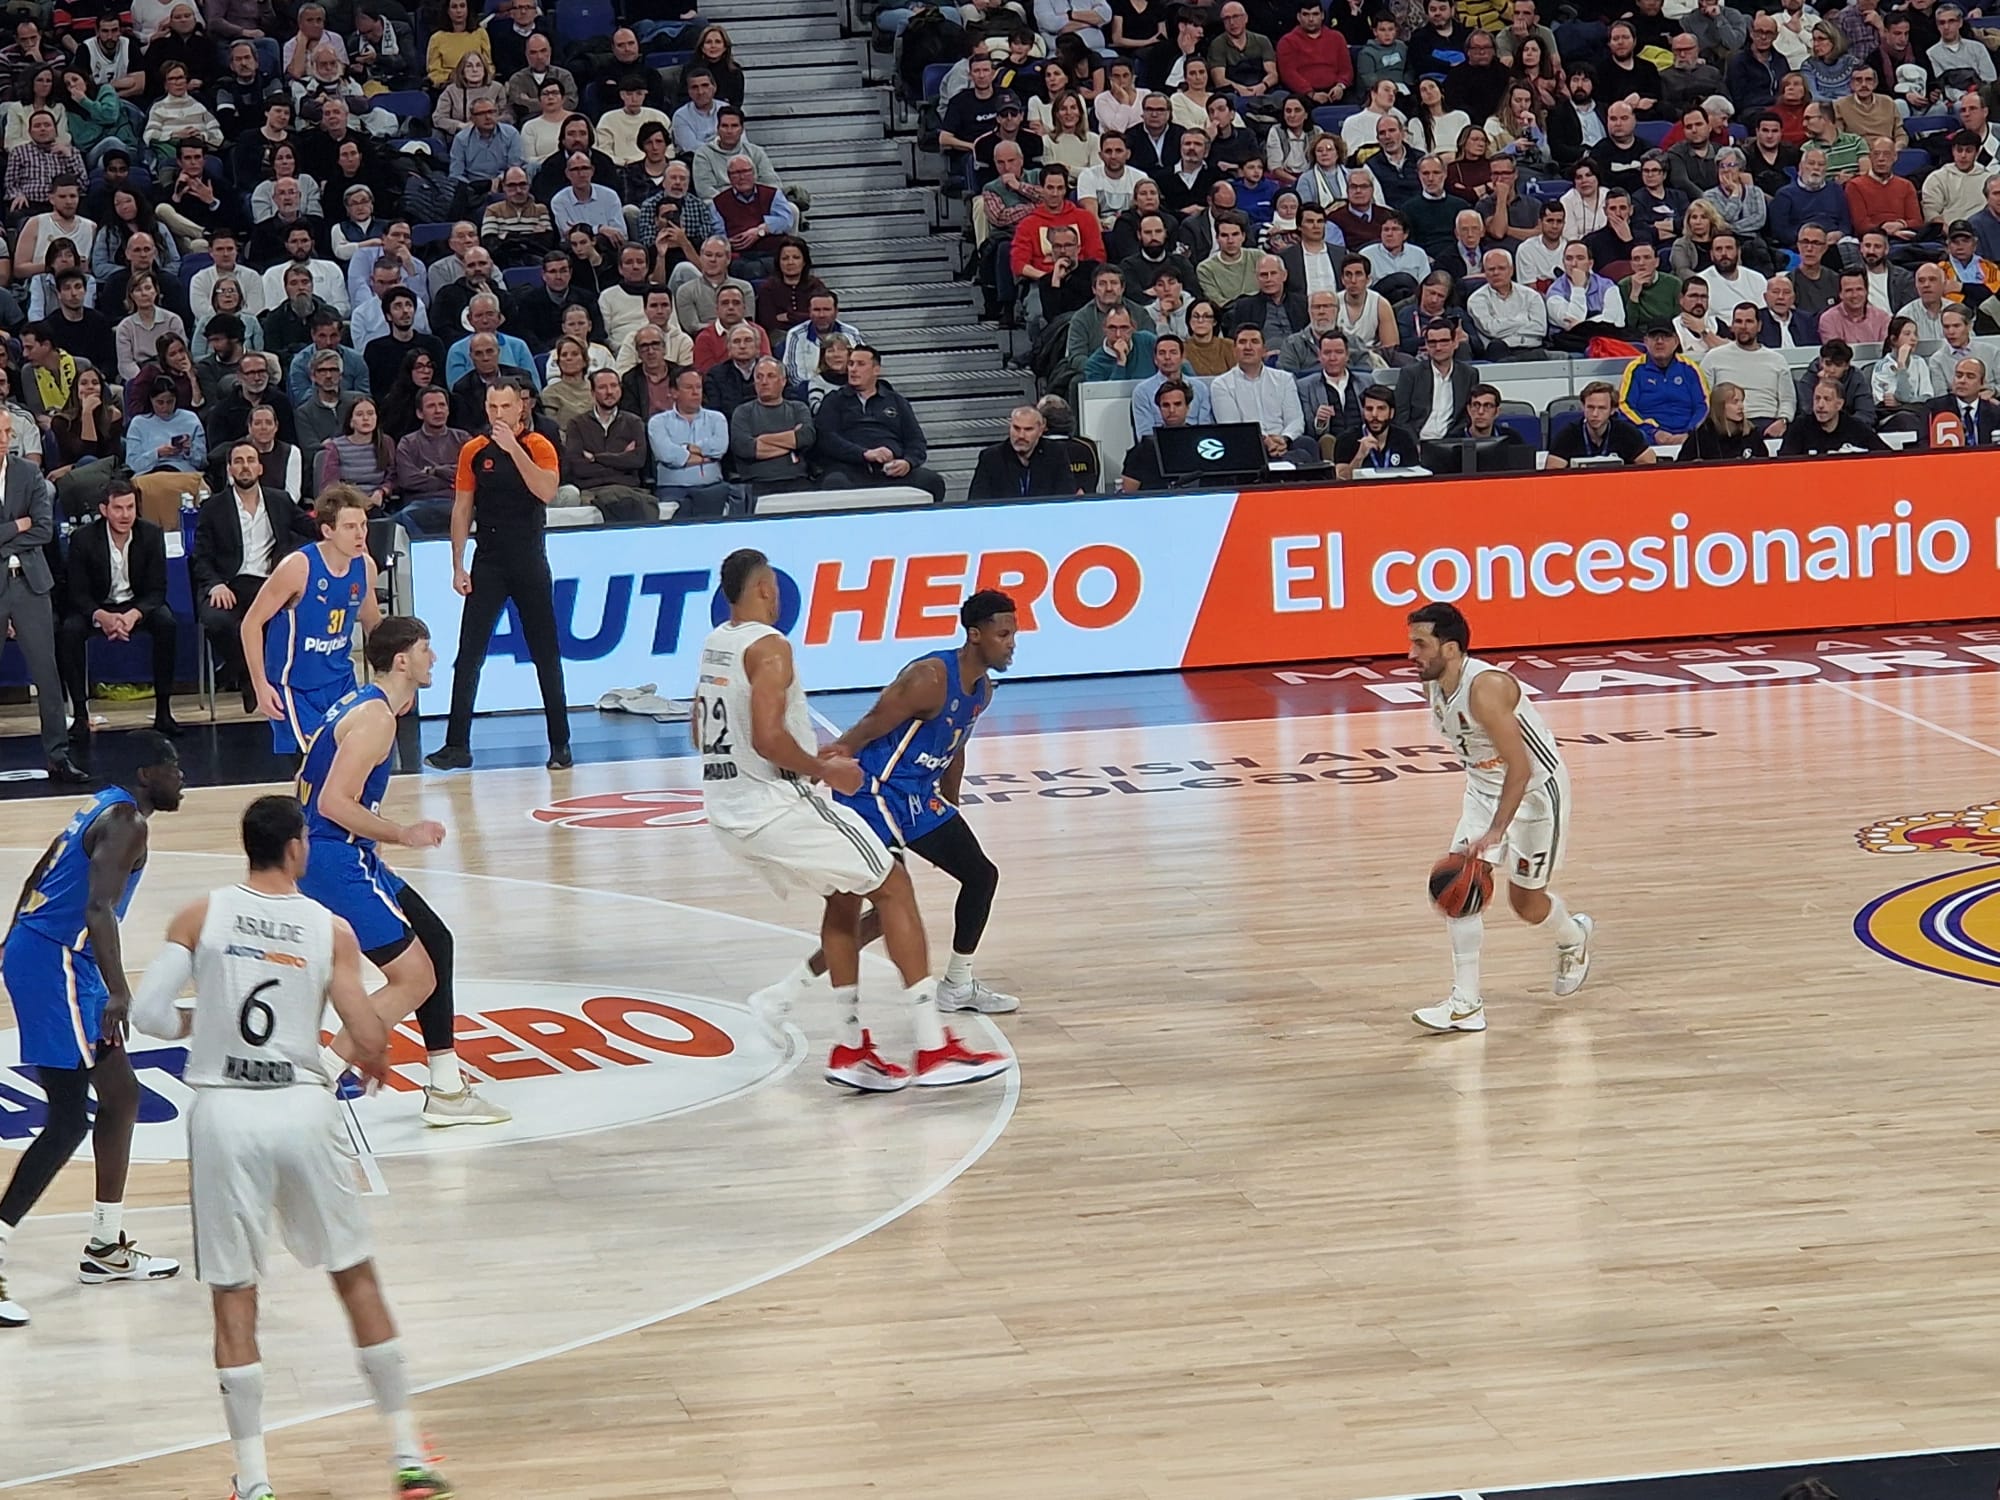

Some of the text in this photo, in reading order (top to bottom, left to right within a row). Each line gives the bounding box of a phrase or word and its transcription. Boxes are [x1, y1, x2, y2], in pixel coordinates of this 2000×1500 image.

[1936, 421, 1960, 447] 5
[1271, 531, 1345, 612] El
[1371, 500, 1970, 606] concesionario
[327, 608, 346, 635] 31
[1272, 644, 1776, 685] Mistar
[964, 726, 1718, 786] RKISH AIRNES
[959, 759, 1466, 805] roLeagu
[1532, 851, 1548, 878] 7
[240, 978, 280, 1047] 6
